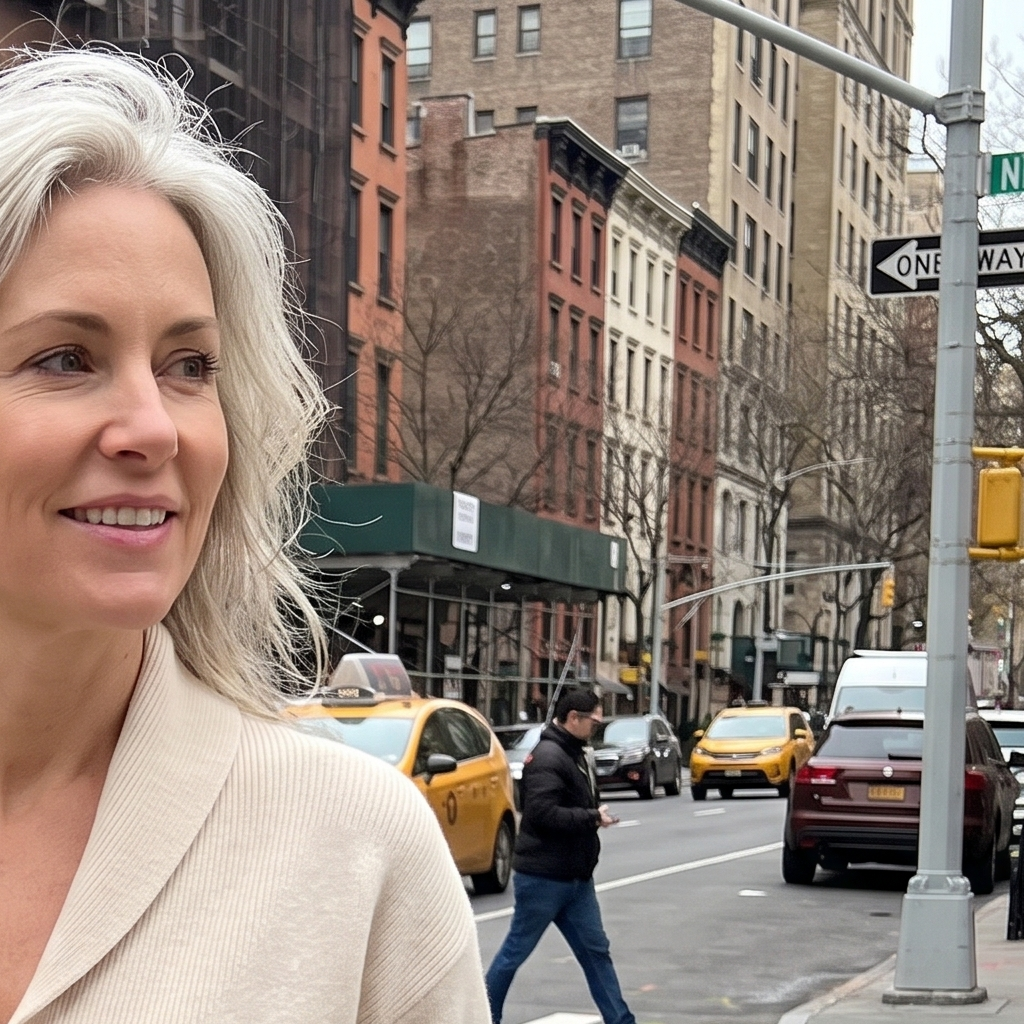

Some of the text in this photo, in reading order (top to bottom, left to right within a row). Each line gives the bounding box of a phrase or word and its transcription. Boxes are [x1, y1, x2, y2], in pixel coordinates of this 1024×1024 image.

[1001, 156, 1024, 191] N
[897, 247, 1024, 276] ONE WAY
